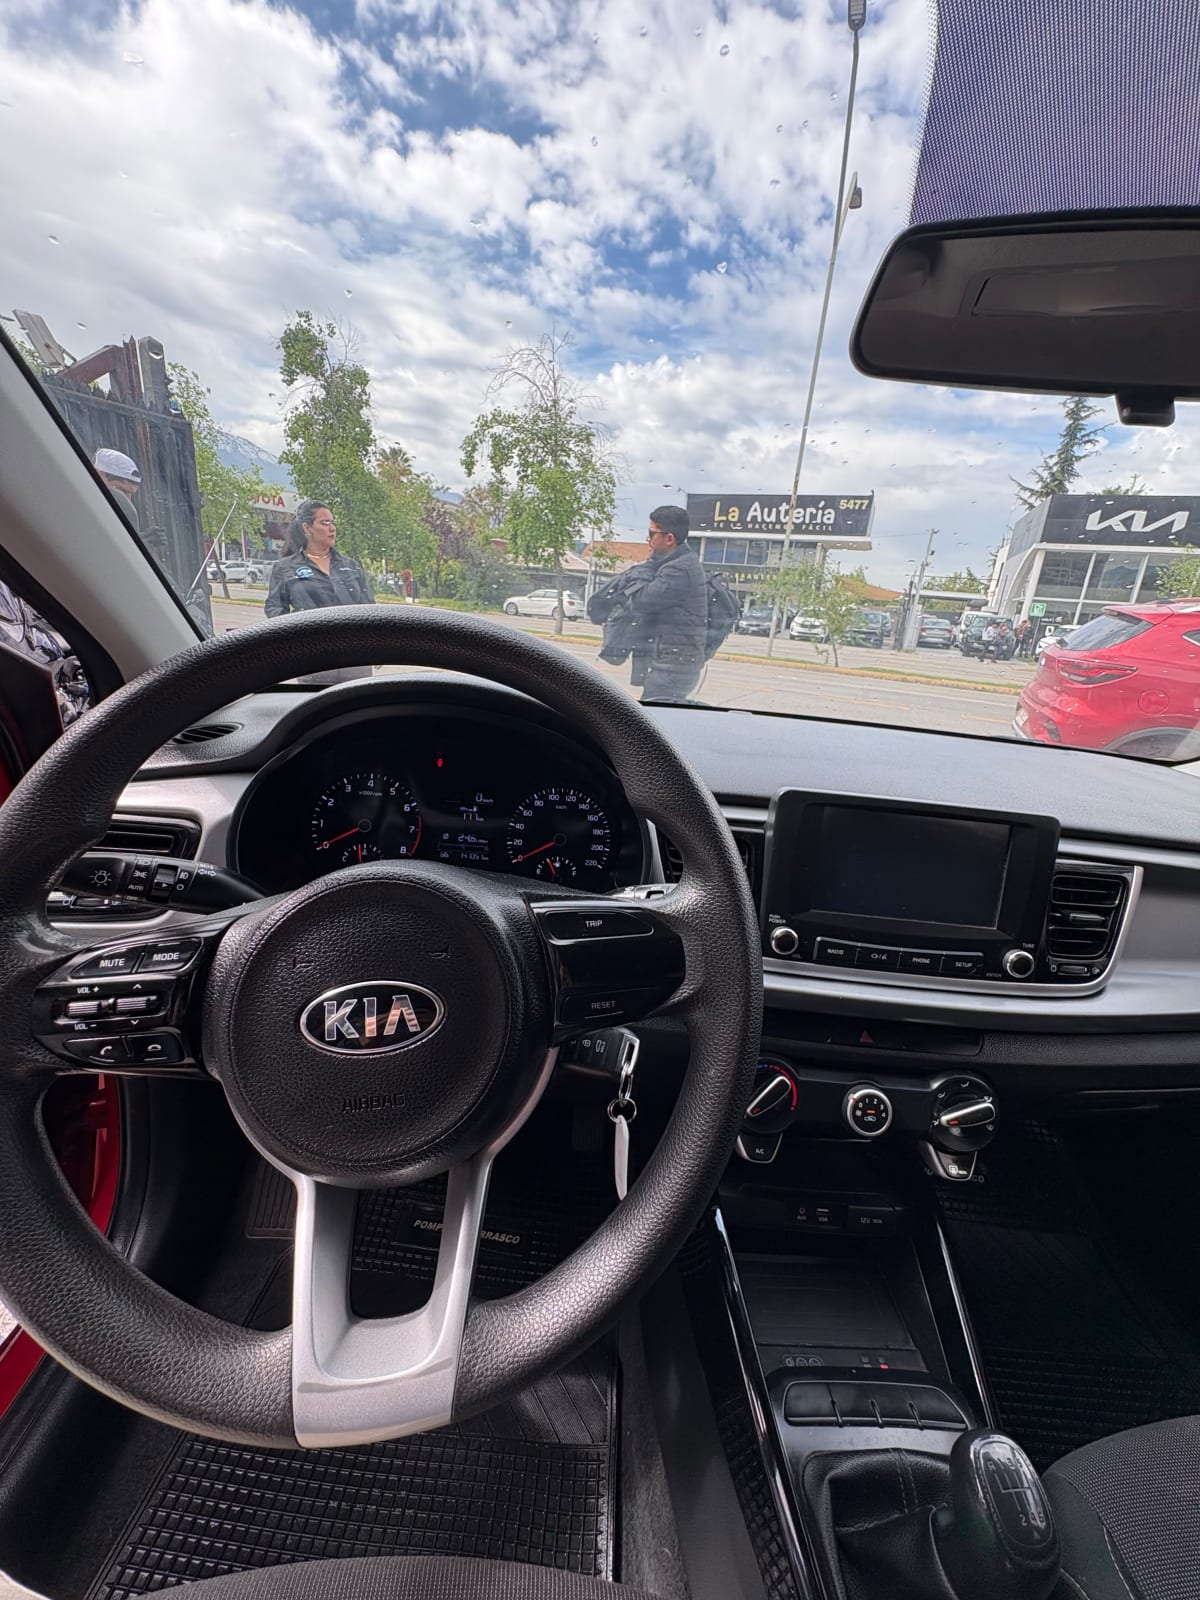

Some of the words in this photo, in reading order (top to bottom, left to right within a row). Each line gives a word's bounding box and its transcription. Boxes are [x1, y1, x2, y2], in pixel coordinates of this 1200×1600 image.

[839, 500, 869, 510] 5477
[714, 502, 740, 522] La
[746, 500, 835, 524] Autería
[1086, 509, 1189, 533] KIA
[390, 788, 396, 796] 5
[404, 804, 411, 812] 6
[128, 884, 144, 892] AUTO
[585, 920, 603, 928] TRIP
[153, 952, 180, 961] MODE
[99, 958, 125, 968] MUTE
[77, 986, 91, 994] VOL
[591, 1000, 616, 1010] RESET
[323, 994, 421, 1041] KIA
[342, 1093, 406, 1113] AIRBAG
